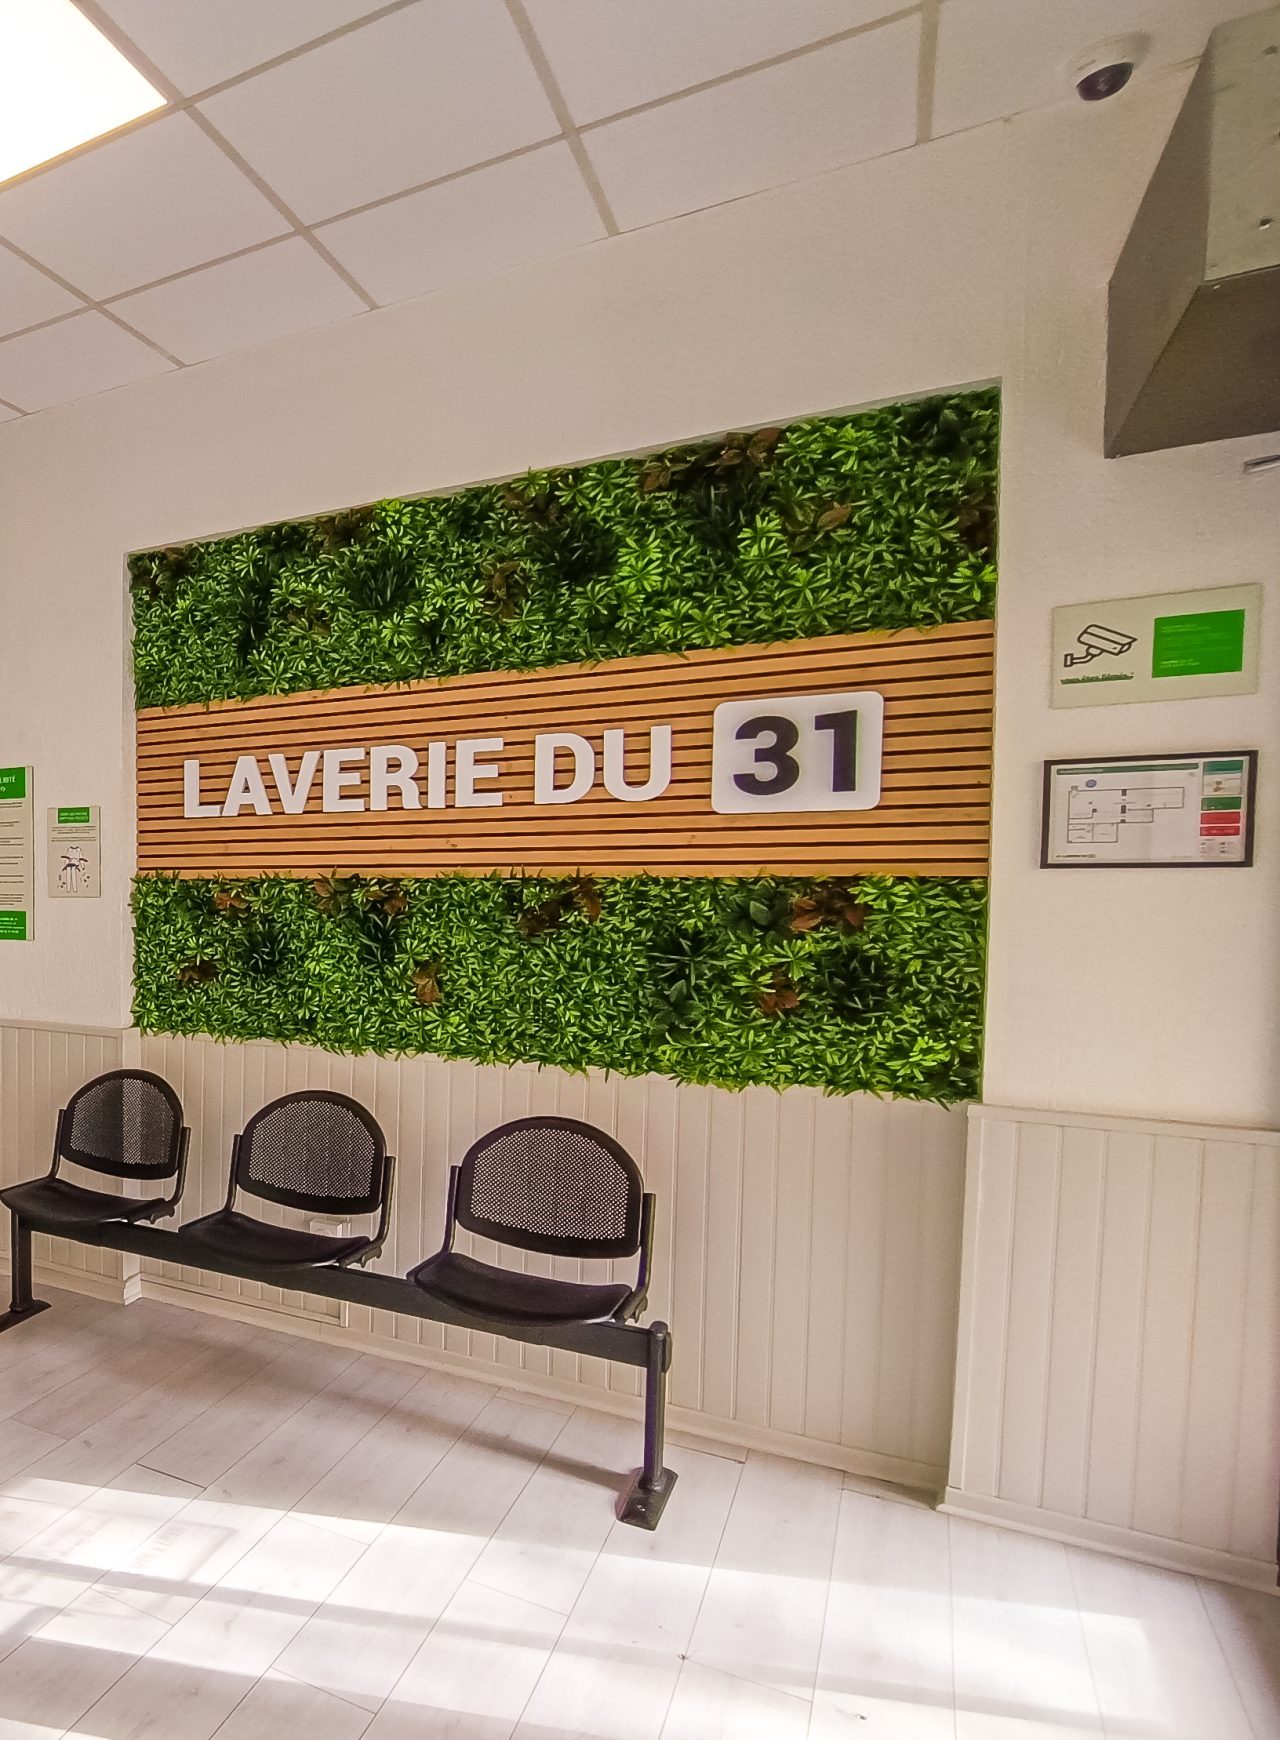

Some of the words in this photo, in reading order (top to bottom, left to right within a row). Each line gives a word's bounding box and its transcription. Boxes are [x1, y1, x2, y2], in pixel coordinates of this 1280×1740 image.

[184, 737, 503, 818] LAVERIE
[534, 724, 671, 804] DU
[733, 709, 858, 795] 31
